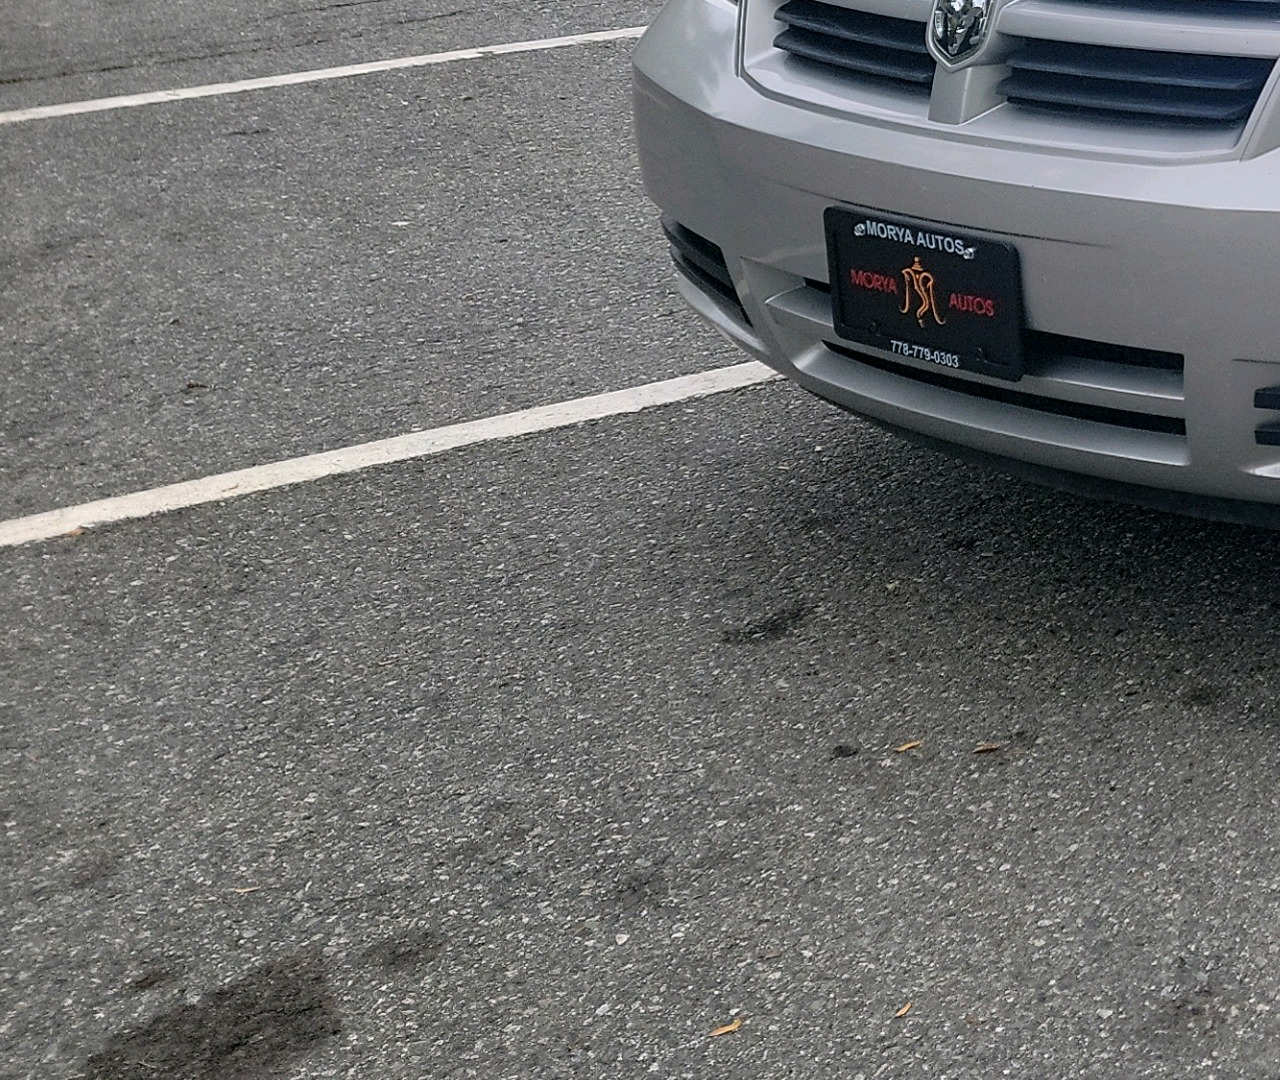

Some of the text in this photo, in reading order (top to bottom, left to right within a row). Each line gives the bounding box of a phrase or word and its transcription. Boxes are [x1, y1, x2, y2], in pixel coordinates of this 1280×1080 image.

[866, 220, 964, 255] MORYA AUTOS
[850, 269, 897, 294] MORYA
[949, 293, 995, 317] AUTOS
[890, 339, 959, 368] 778-779-0303
